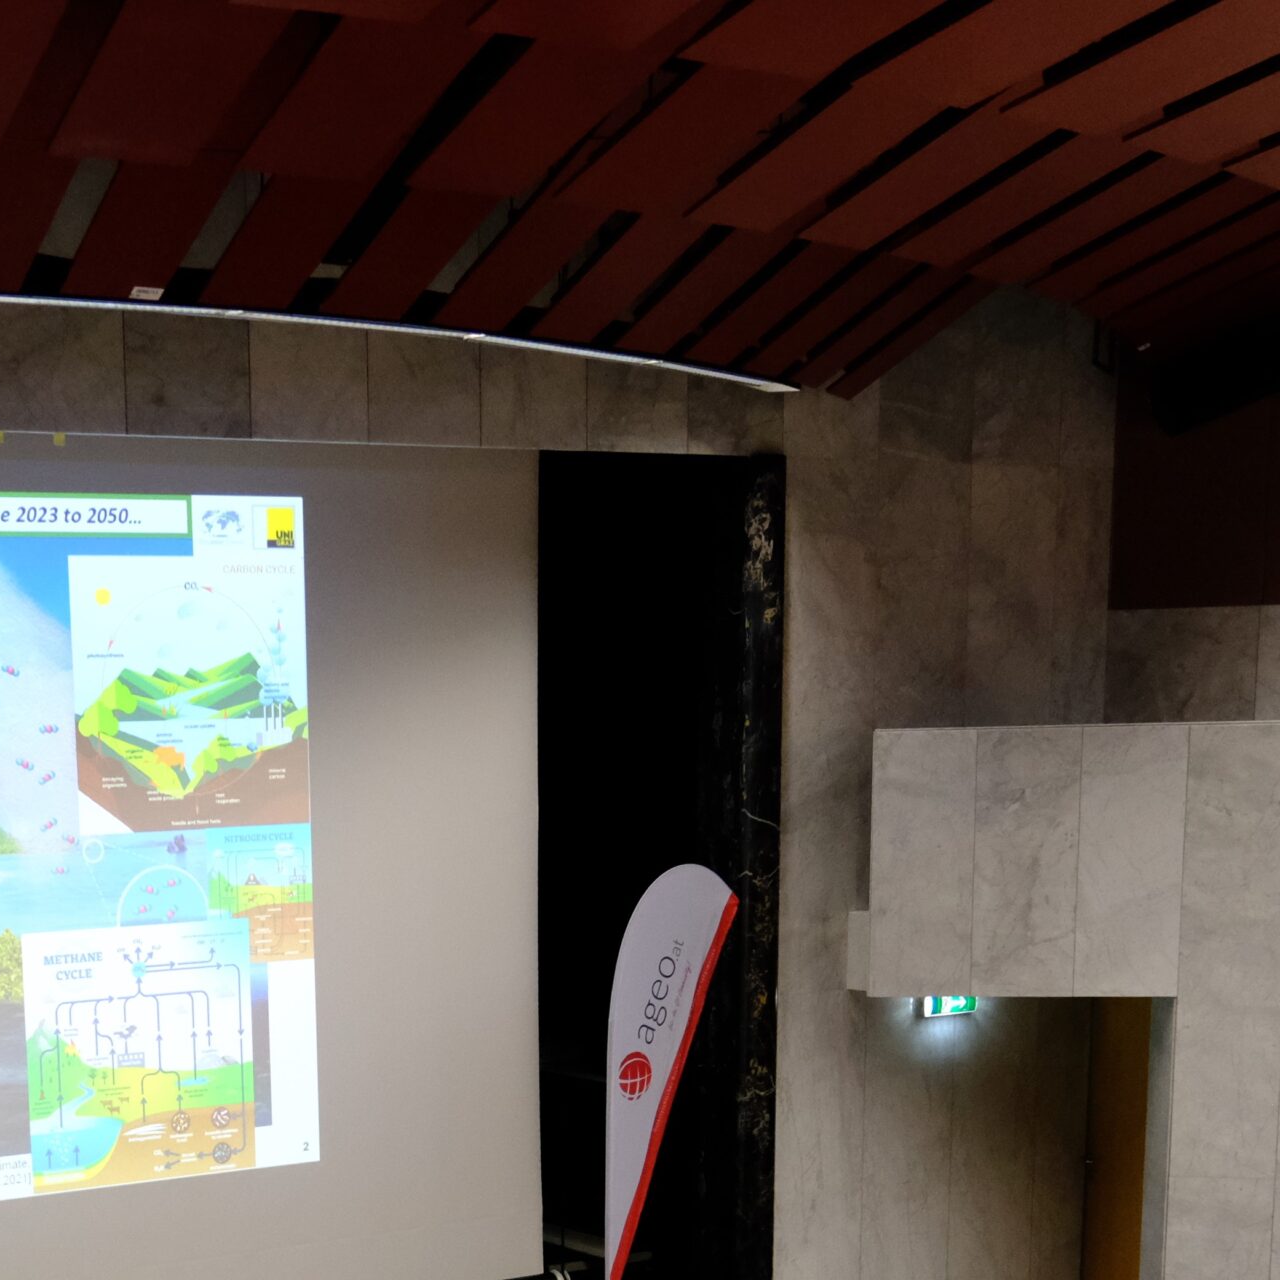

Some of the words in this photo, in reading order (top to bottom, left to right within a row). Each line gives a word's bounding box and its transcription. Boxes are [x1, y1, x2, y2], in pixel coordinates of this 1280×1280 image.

[15, 506, 59, 524] 2023
[63, 506, 82, 524] to
[275, 529, 294, 539] UNI
[43, 952, 103, 966] METHANE
[55, 968, 93, 981] CYCLE
[303, 1142, 310, 1151] 2
